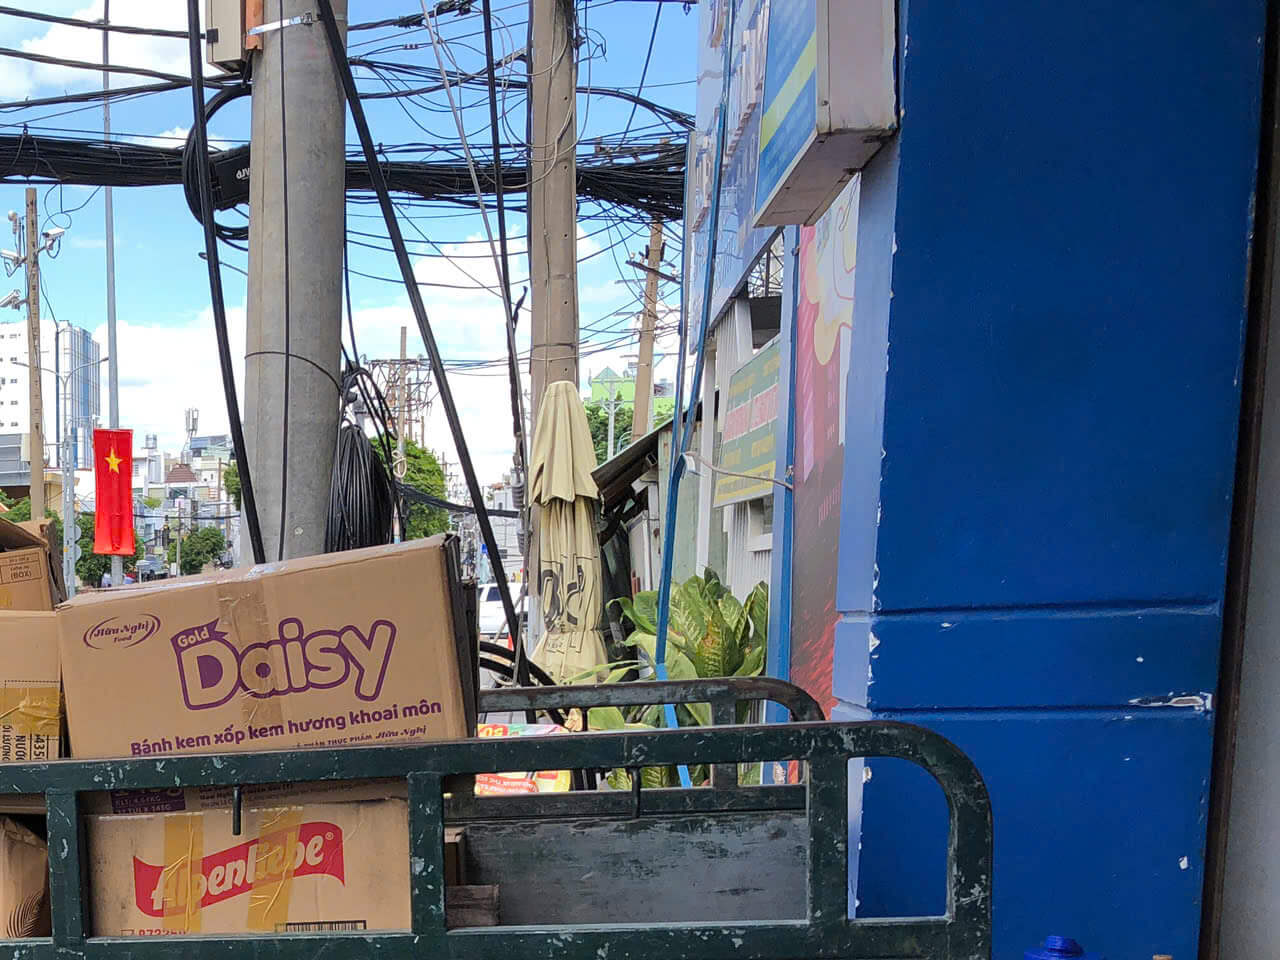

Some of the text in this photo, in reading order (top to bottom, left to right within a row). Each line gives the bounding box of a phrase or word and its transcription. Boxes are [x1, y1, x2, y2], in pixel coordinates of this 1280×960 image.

[173, 617, 397, 711] Daisy
[177, 626, 210, 647] Gold
[131, 699, 442, 757] Bánh kem xốp kem hương khoai môn
